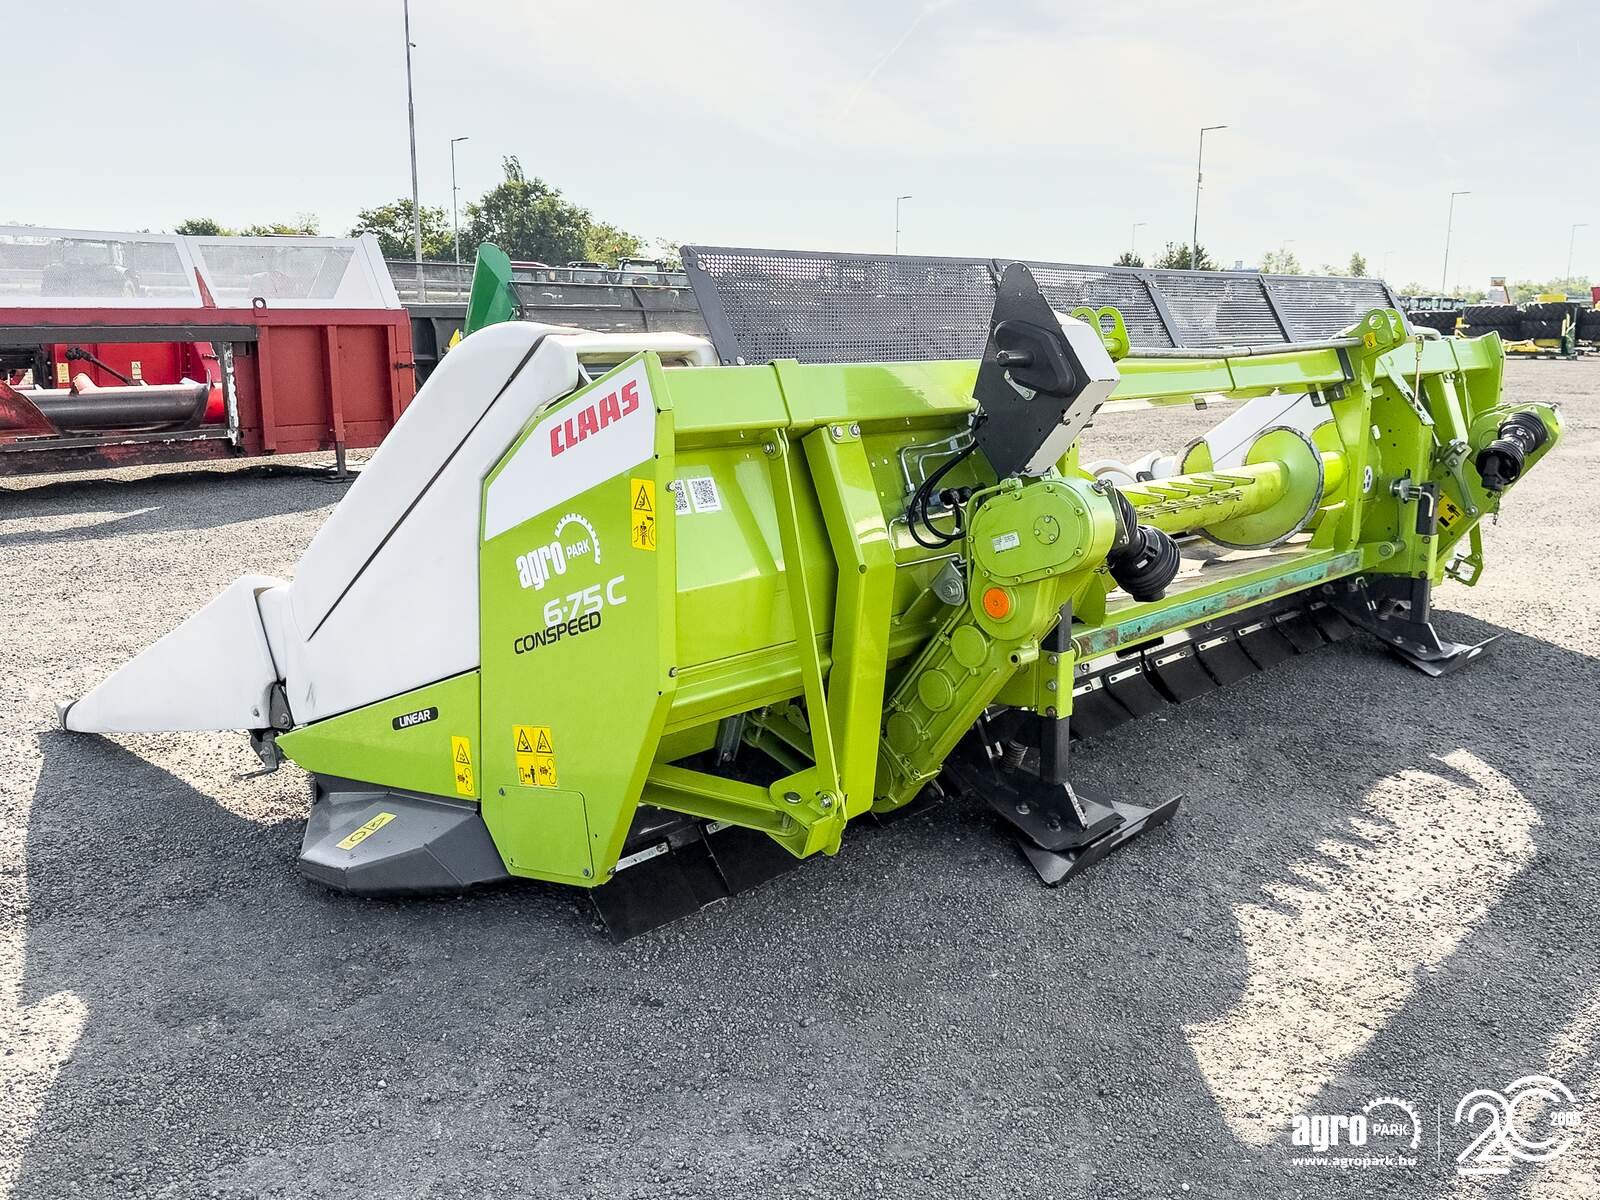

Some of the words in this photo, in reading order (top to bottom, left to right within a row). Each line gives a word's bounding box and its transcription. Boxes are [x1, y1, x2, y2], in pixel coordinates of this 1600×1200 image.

[550, 379, 639, 457] CLAAS
[515, 541, 567, 591] agro
[566, 539, 591, 560] PARK
[514, 611, 602, 655] CONSPEED
[399, 709, 431, 728] LINEAR
